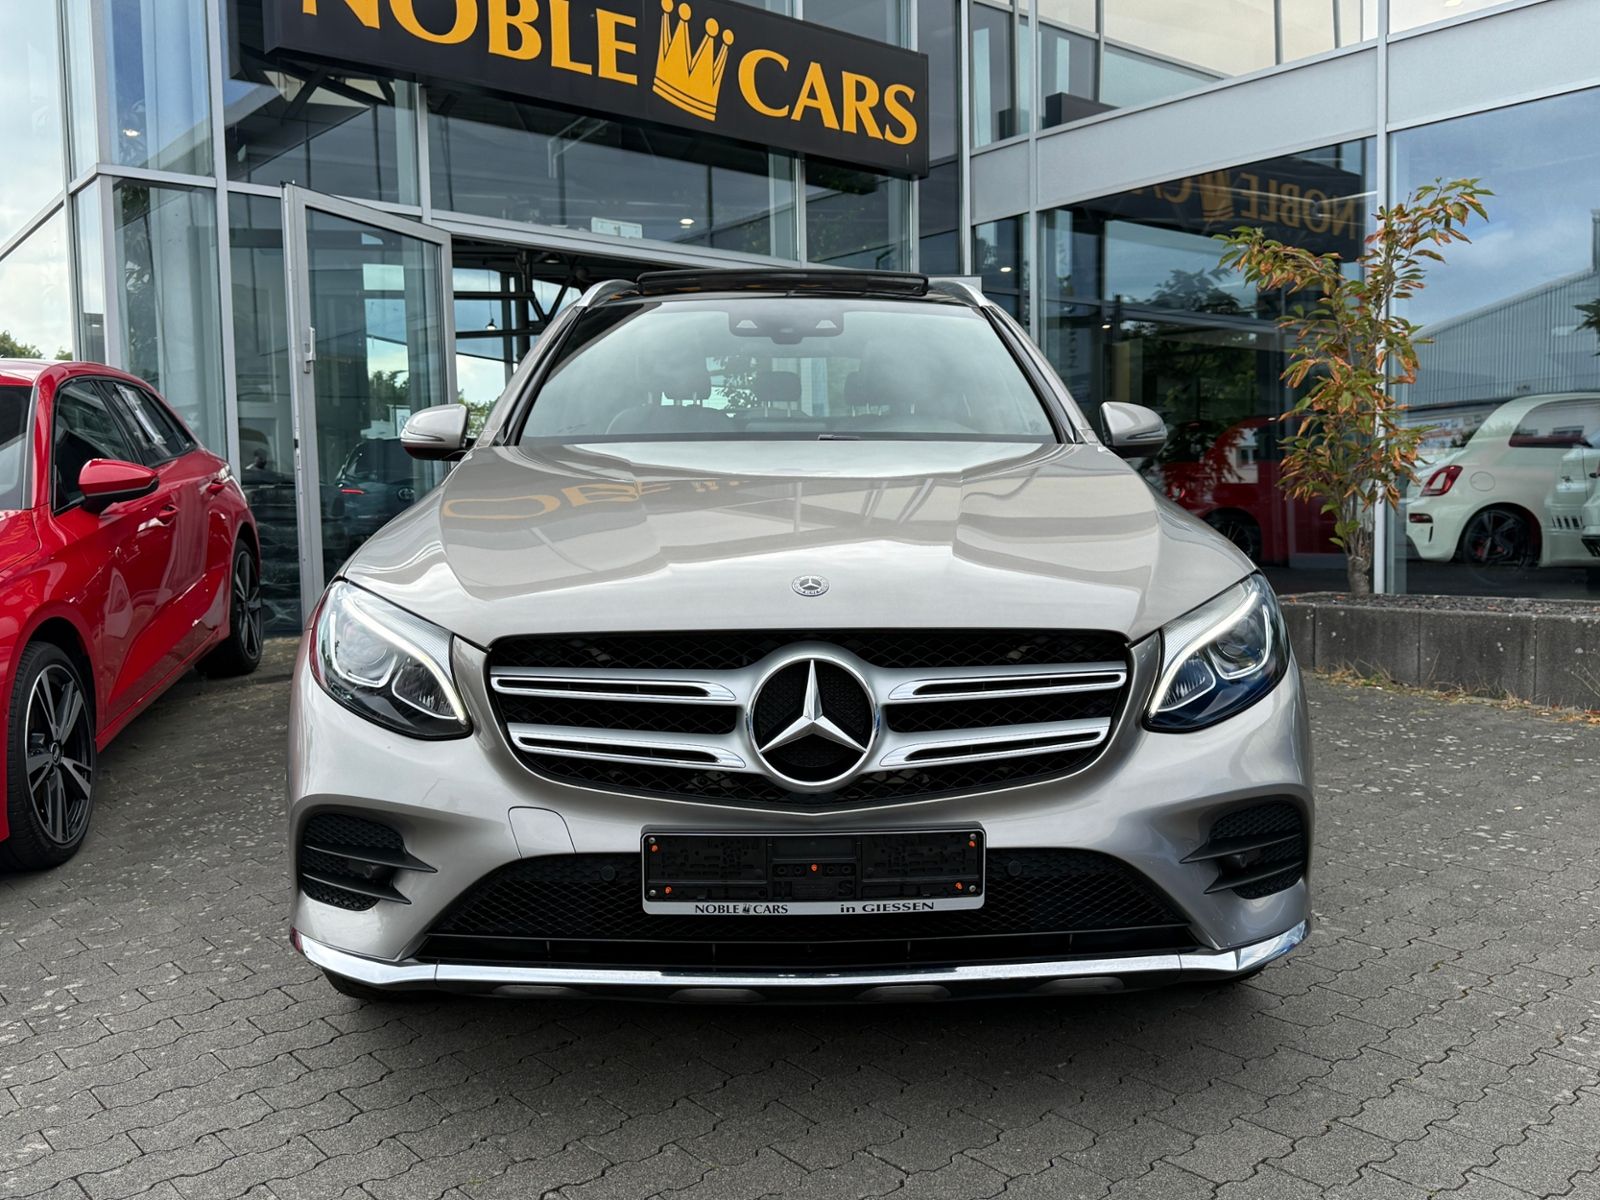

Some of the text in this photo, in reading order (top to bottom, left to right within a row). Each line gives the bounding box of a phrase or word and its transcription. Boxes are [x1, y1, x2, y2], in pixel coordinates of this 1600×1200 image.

[738, 49, 917, 145] CARS
[695, 902, 935, 914] NOBLE CARS in GIESSEN
